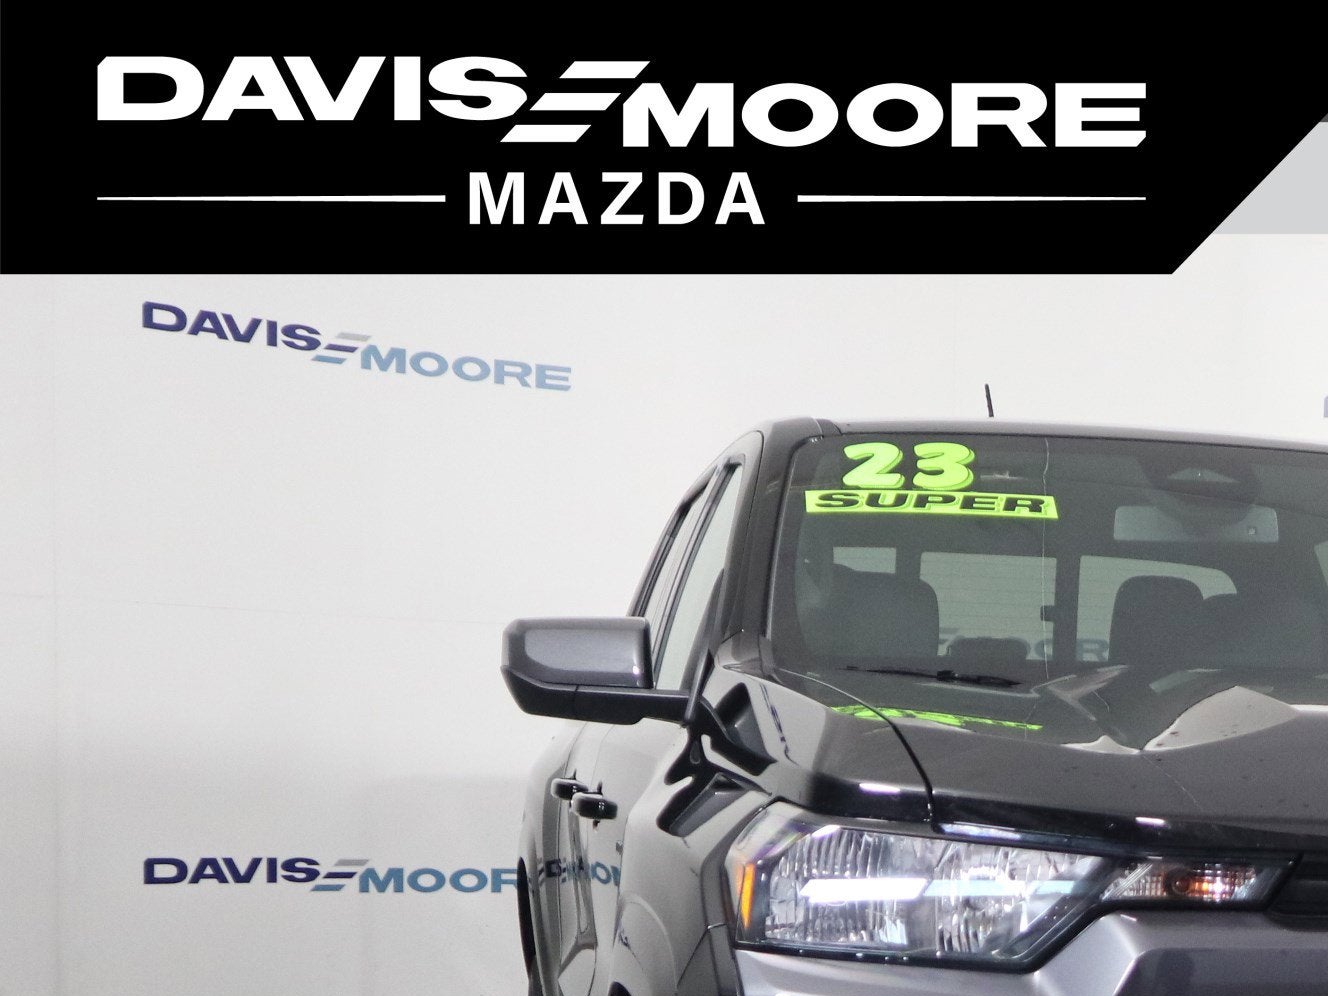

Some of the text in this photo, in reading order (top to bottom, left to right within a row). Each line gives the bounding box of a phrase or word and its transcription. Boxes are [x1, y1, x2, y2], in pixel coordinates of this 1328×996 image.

[142, 301, 572, 392] DAVIS MOORE
[842, 442, 975, 490] 23
[814, 491, 1046, 514] SUPER
[143, 856, 321, 884] DAVIS
